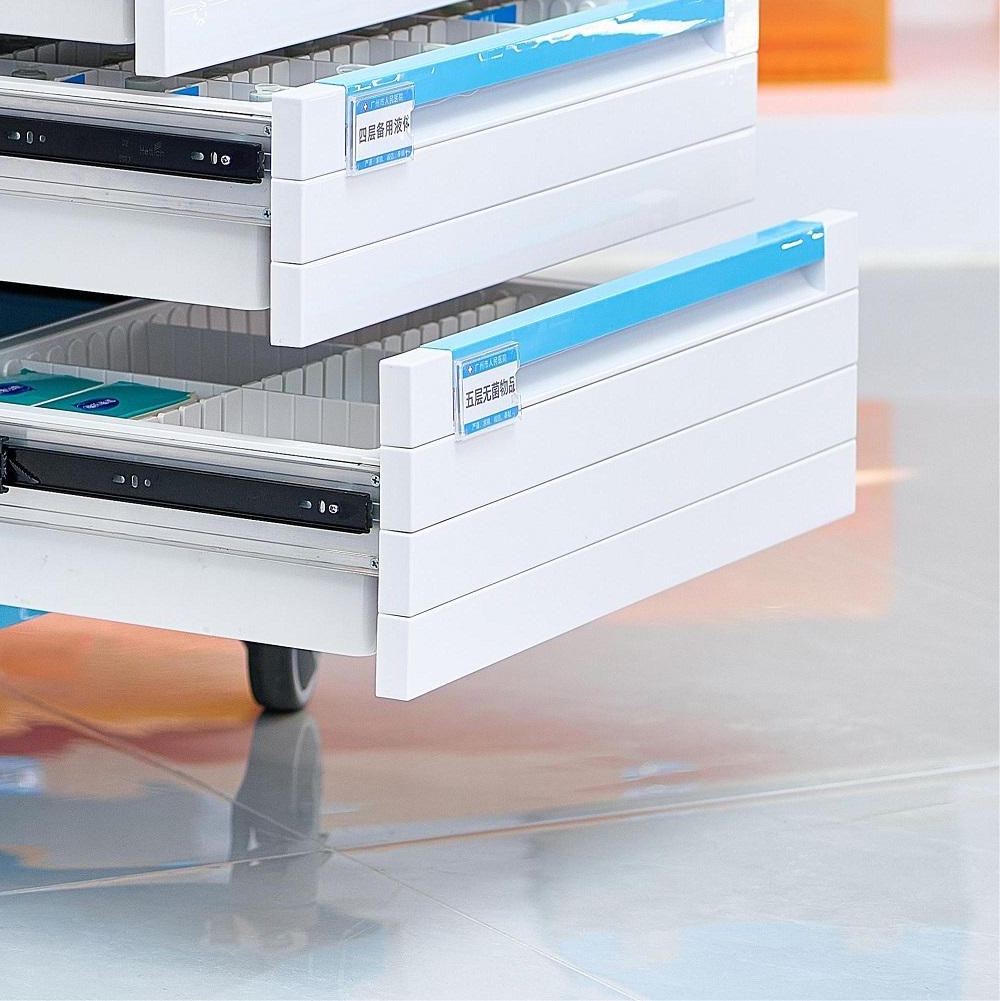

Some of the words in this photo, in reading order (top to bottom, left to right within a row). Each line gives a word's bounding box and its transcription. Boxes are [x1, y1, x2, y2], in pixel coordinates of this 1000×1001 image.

[465, 375, 516, 409] 五层无菌物品
